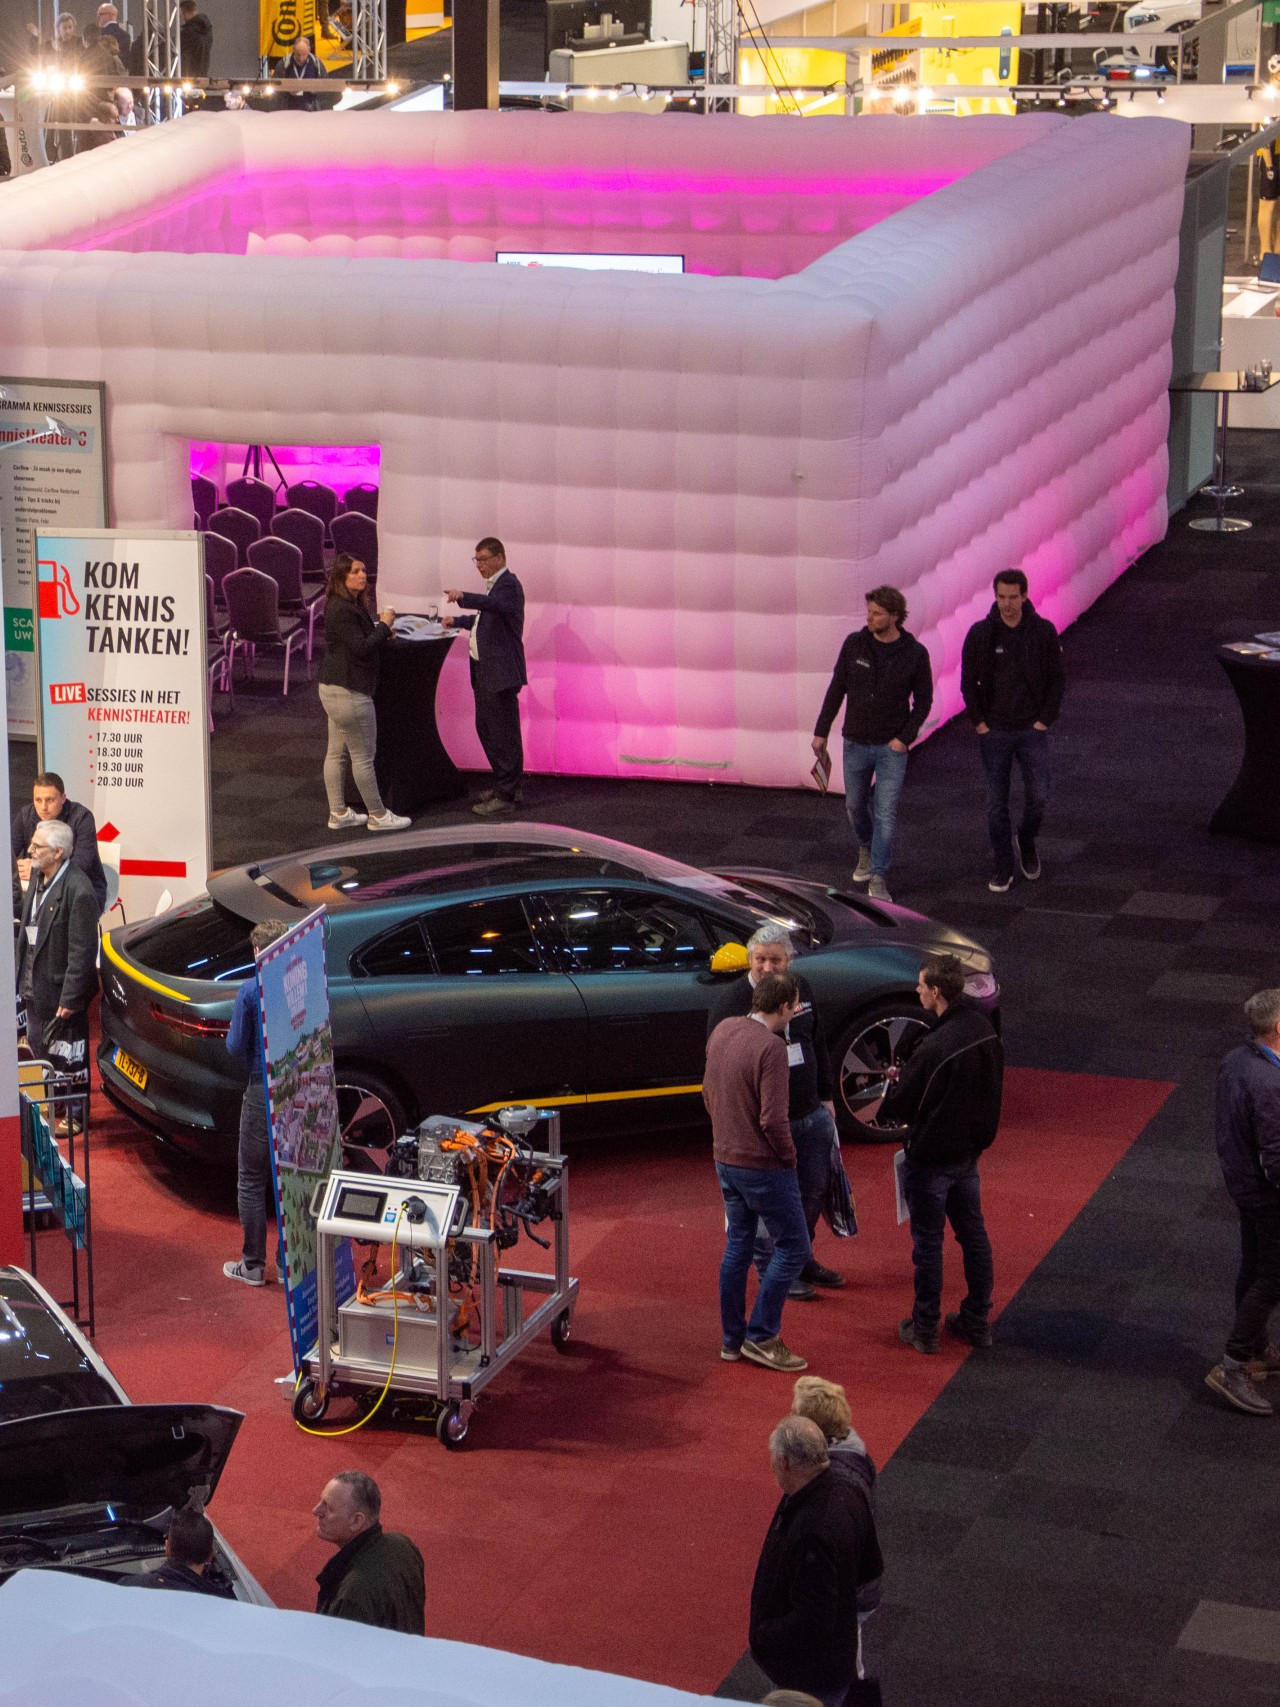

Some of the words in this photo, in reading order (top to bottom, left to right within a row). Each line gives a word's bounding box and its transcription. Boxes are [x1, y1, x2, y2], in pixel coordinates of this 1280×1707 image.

[33, 402, 92, 414] KENNISSESSIES
[83, 561, 139, 589] KOM
[85, 594, 175, 623] KENNIS
[86, 626, 190, 656] TANKEN!
[54, 685, 83, 702] LIVE
[87, 688, 136, 703] SESSIES
[140, 690, 153, 703] IN
[157, 691, 181, 705] HET
[87, 708, 191, 725] KENNISTHEATER!
[96, 732, 121, 743] 17.30
[123, 733, 143, 744] UUR
[96, 747, 122, 758] 18.30
[124, 748, 143, 758] UUR
[97, 762, 122, 772] 19.30
[124, 763, 144, 773] UUR
[97, 776, 122, 787] 20.30
[125, 777, 144, 788] UUR
